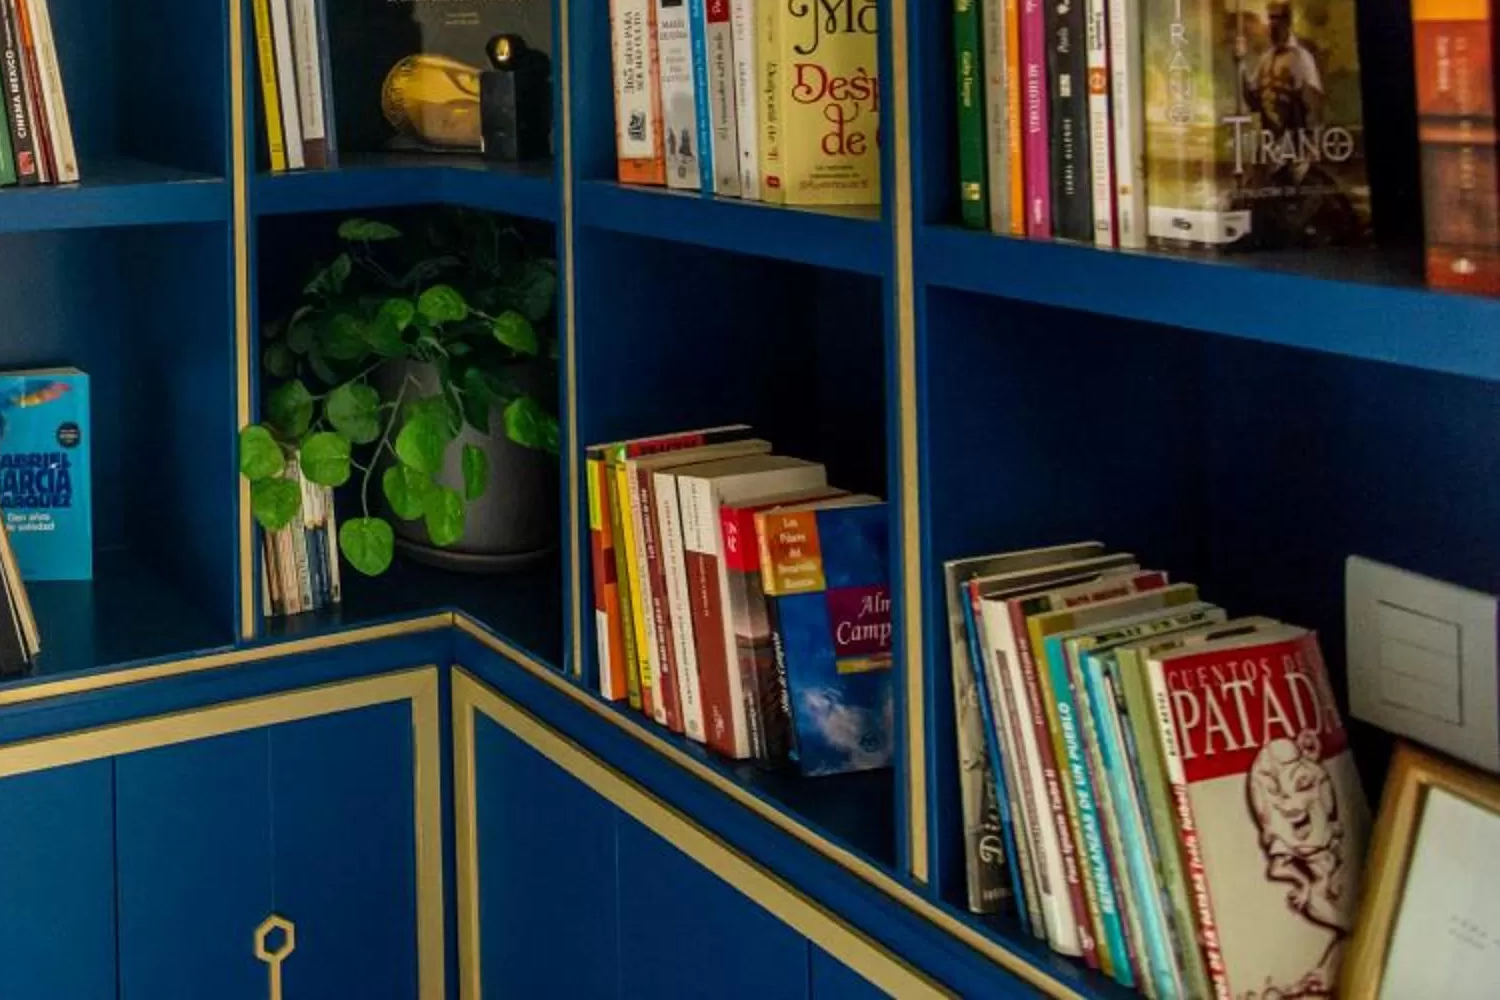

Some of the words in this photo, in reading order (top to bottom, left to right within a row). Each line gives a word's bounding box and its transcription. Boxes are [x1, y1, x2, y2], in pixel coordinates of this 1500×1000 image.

[10, 95, 28, 139] CINEMA
[821, 103, 868, 156] de
[1221, 115, 1354, 175] TIRANO
[857, 591, 891, 620] Alm
[836, 621, 892, 647] Camp
[1167, 656, 1273, 692] CUENTOS
[1057, 701, 1081, 761] PUEBLO
[1072, 763, 1091, 788] UN
[1079, 790, 1096, 812] DE
[1088, 813, 1115, 916] SEMBLANZAS
